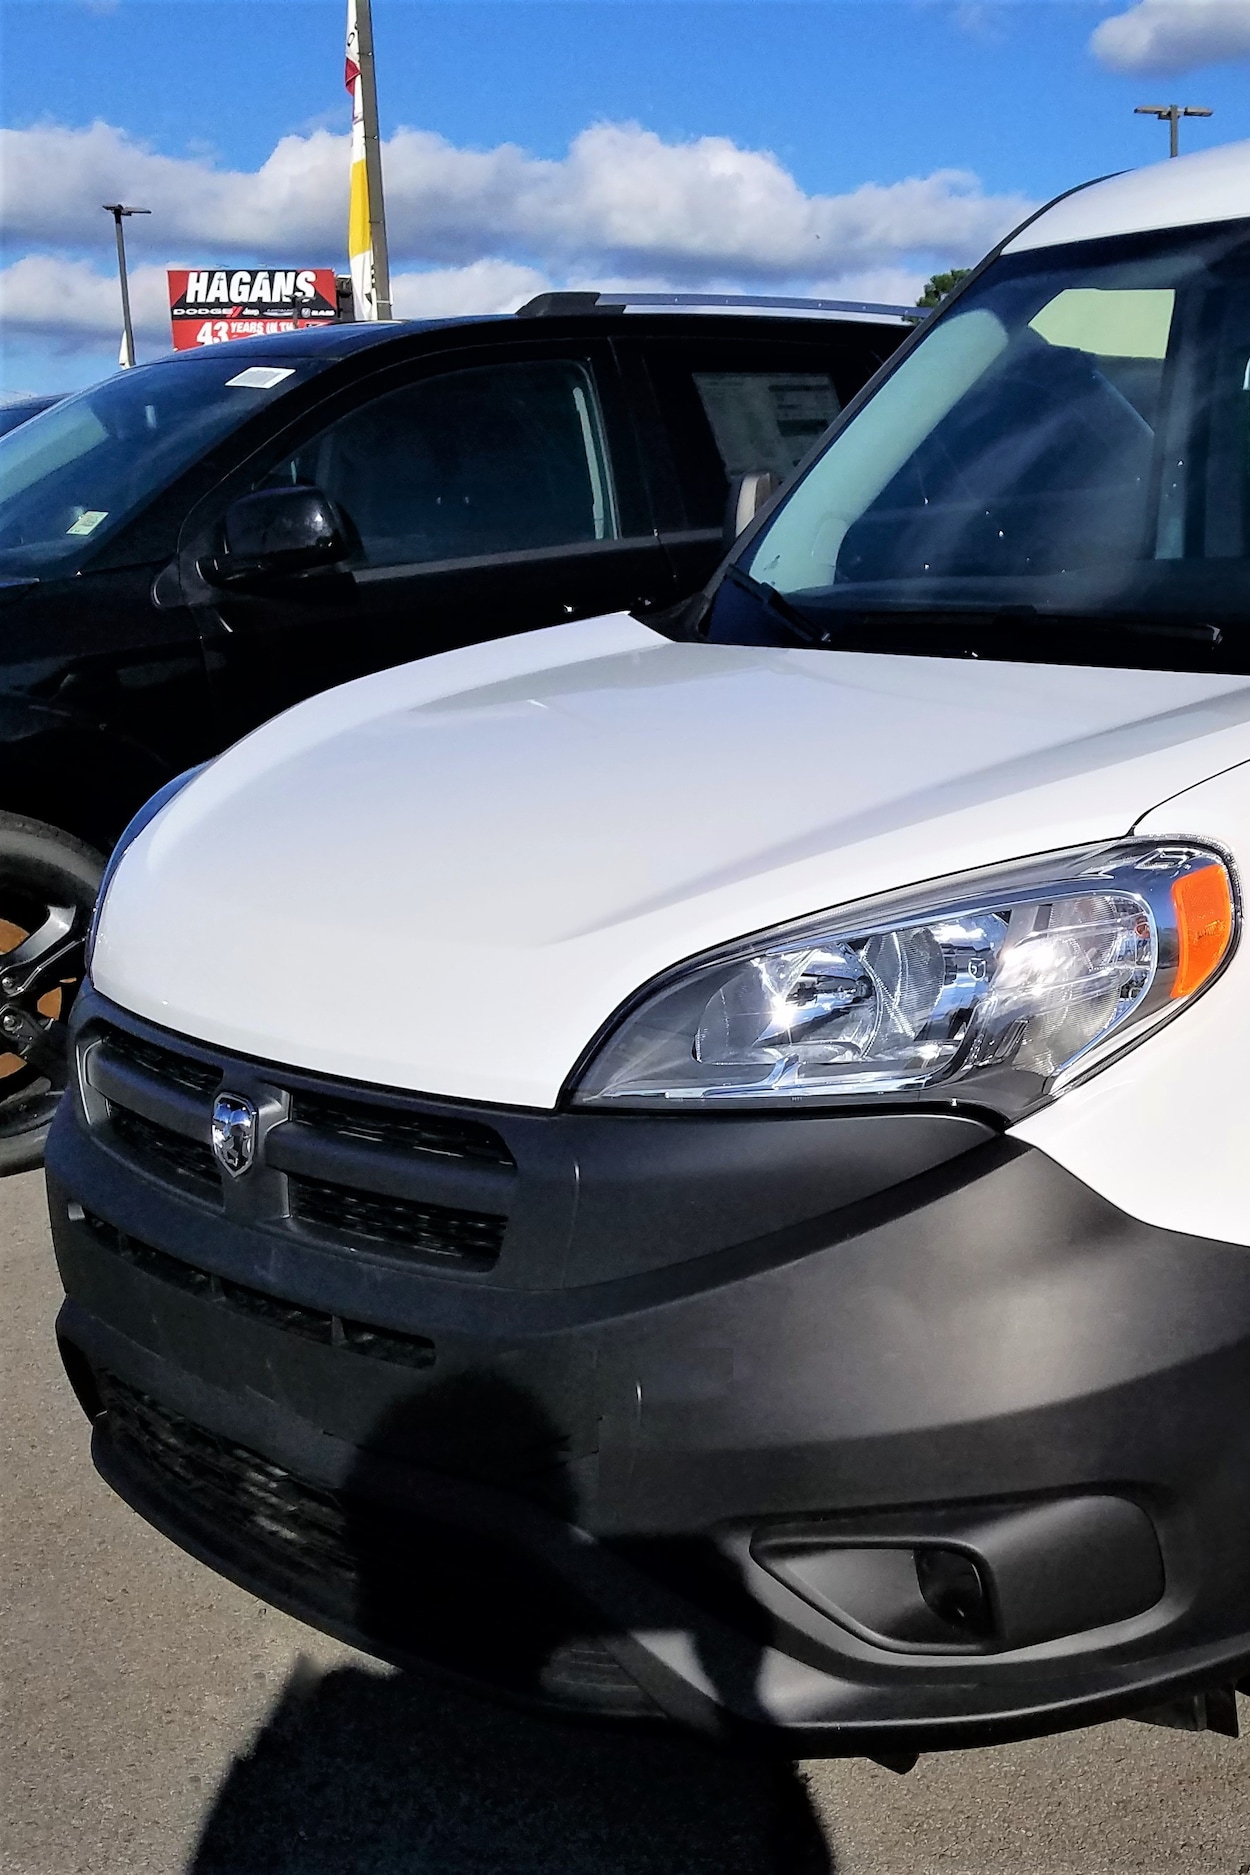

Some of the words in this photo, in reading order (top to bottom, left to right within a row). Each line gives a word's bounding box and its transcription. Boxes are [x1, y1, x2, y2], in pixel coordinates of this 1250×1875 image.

[186, 270, 316, 303] HAGANS
[173, 308, 233, 316] DODGE
[196, 321, 230, 346] 43
[231, 321, 263, 334] YEARS
